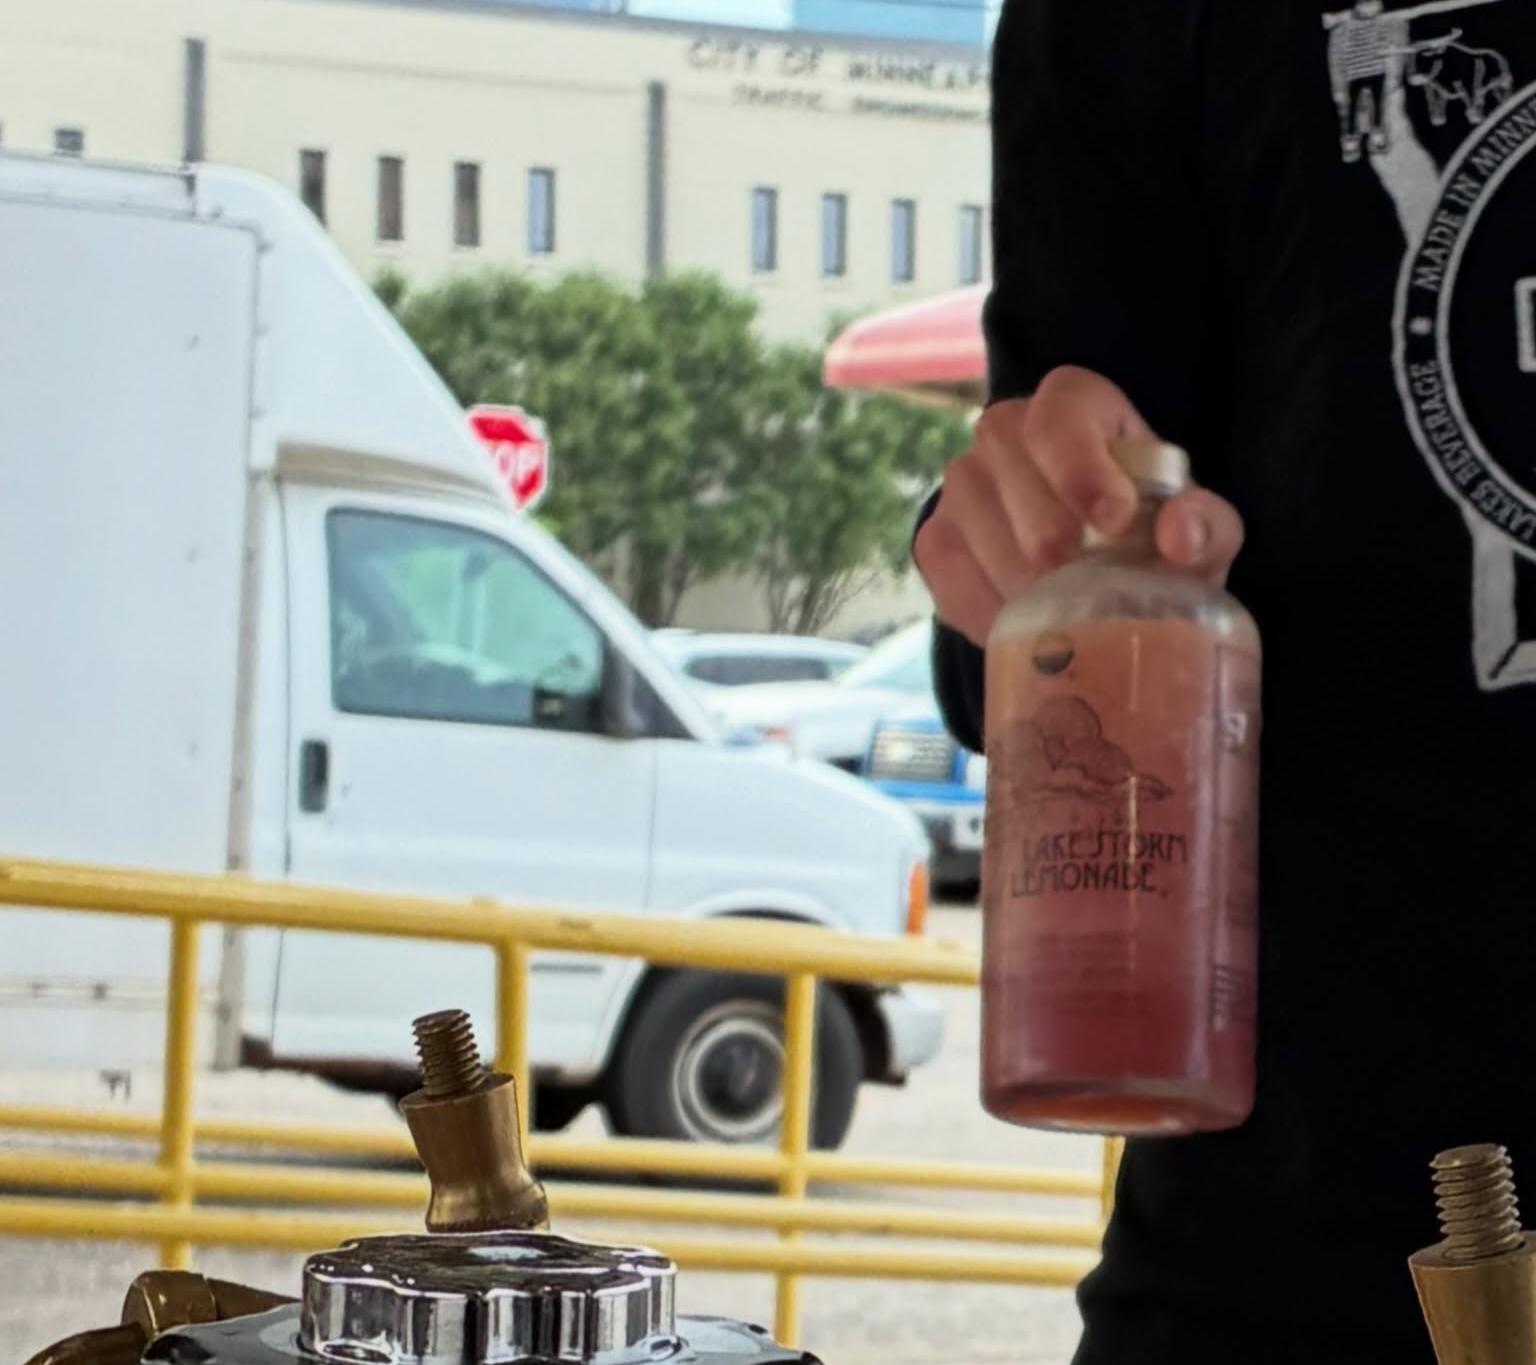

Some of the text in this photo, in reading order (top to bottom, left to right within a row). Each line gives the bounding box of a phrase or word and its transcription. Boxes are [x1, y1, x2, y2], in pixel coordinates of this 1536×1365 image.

[1411, 208, 1464, 292] MADE
[1445, 173, 1483, 208] IN
[1408, 359, 1483, 486] BEVERAGE
[1009, 860, 1158, 899] LEMONADE
